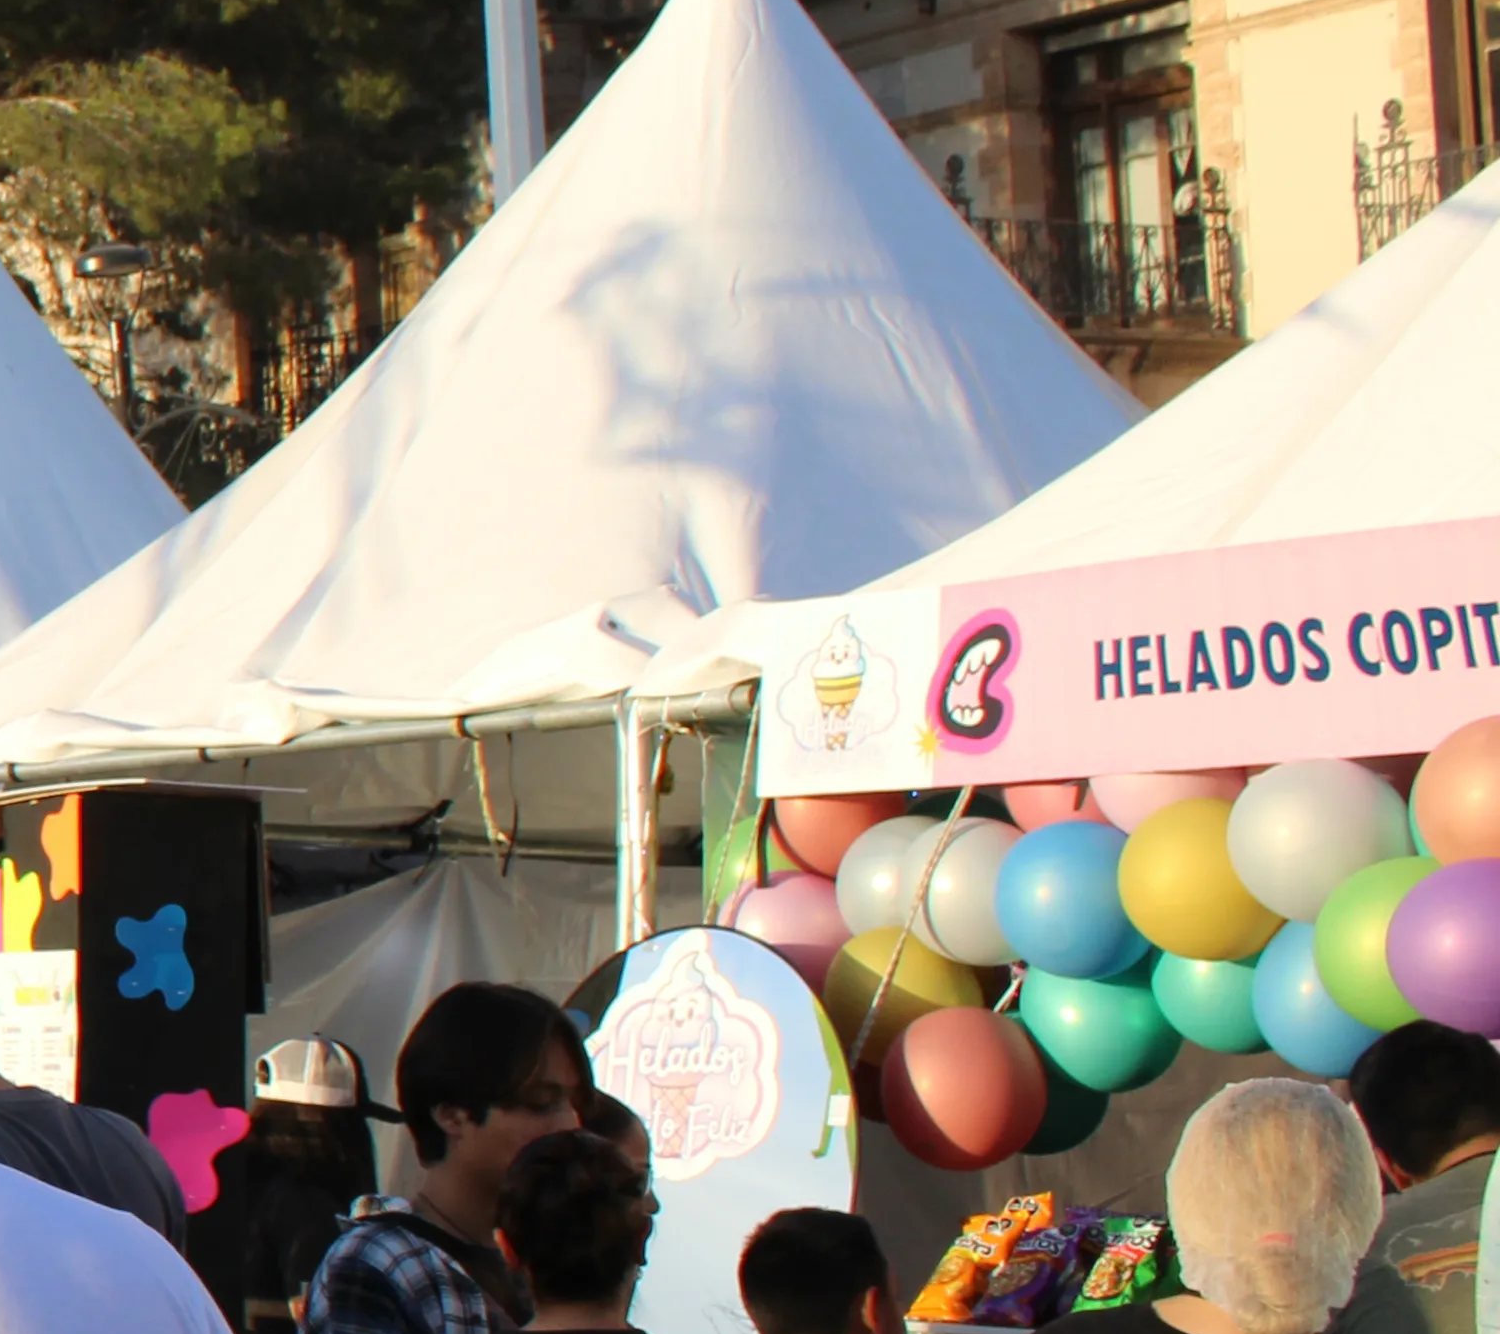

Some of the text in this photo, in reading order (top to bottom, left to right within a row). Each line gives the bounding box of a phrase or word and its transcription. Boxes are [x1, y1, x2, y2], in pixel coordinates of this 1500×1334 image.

[1094, 601, 1500, 701] HELADOS COPIT
[606, 1021, 750, 1105] Helados
[681, 1103, 750, 1160] Feliz
